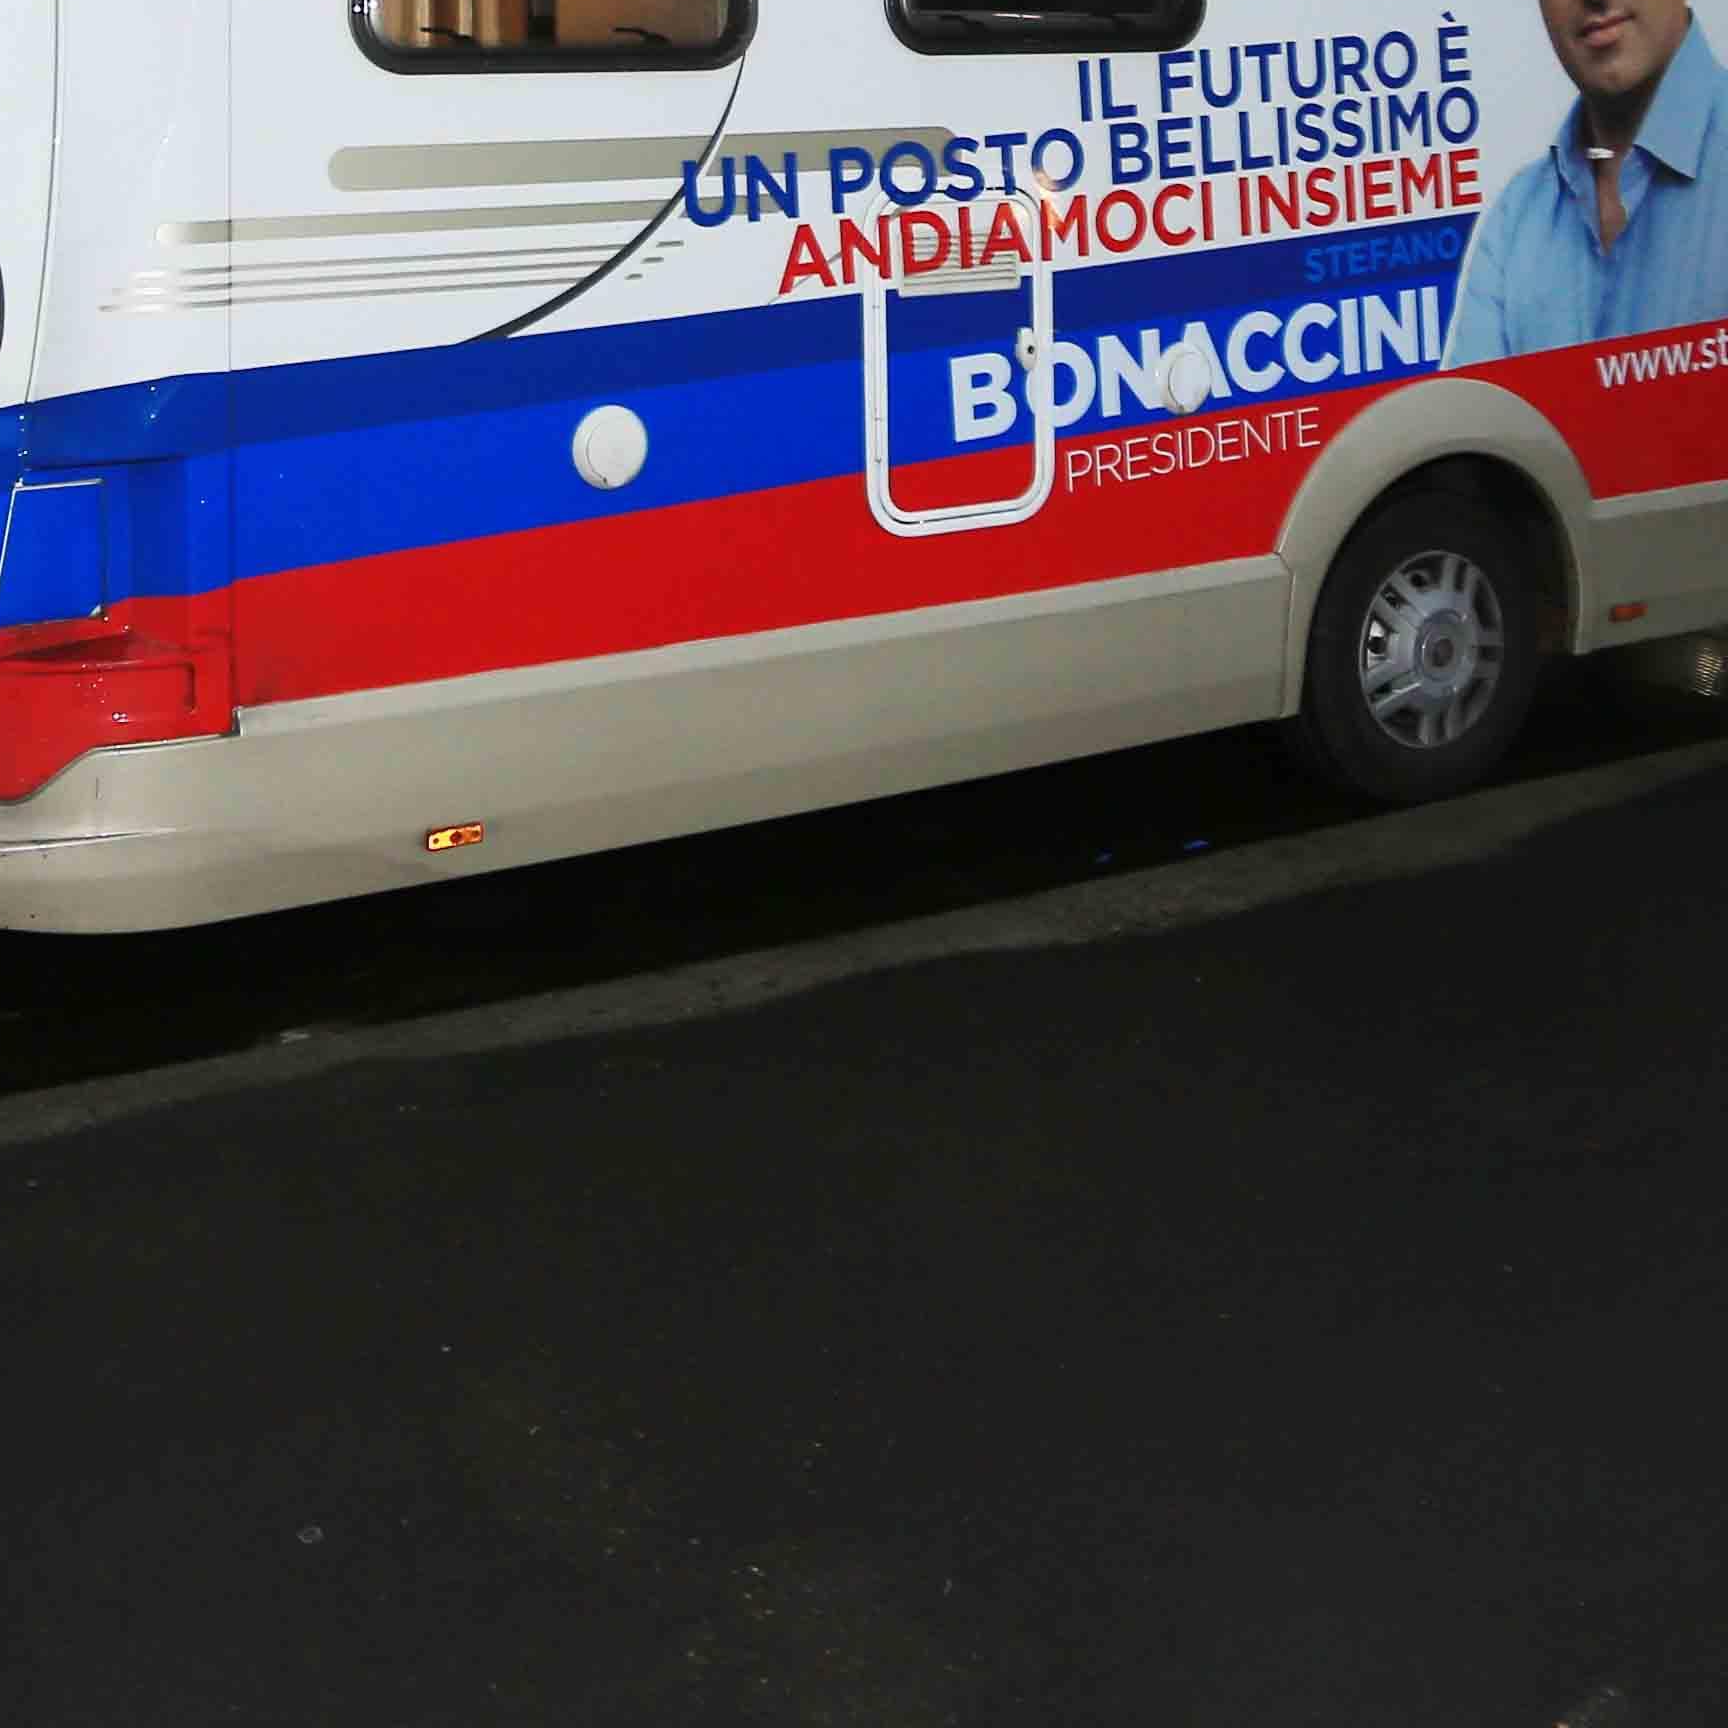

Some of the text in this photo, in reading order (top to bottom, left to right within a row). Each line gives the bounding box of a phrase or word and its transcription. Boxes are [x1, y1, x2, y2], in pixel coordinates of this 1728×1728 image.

[1078, 11, 1471, 123] IL FUTURO È
[682, 86, 1481, 228] UN POSTO BELLISSIMO
[780, 147, 1483, 294] ANDIAMOCI INSIEME
[1305, 227, 1460, 284] STEFANO
[950, 286, 1442, 444] BONACCINI
[1065, 407, 1322, 492] PRESIDENTE
